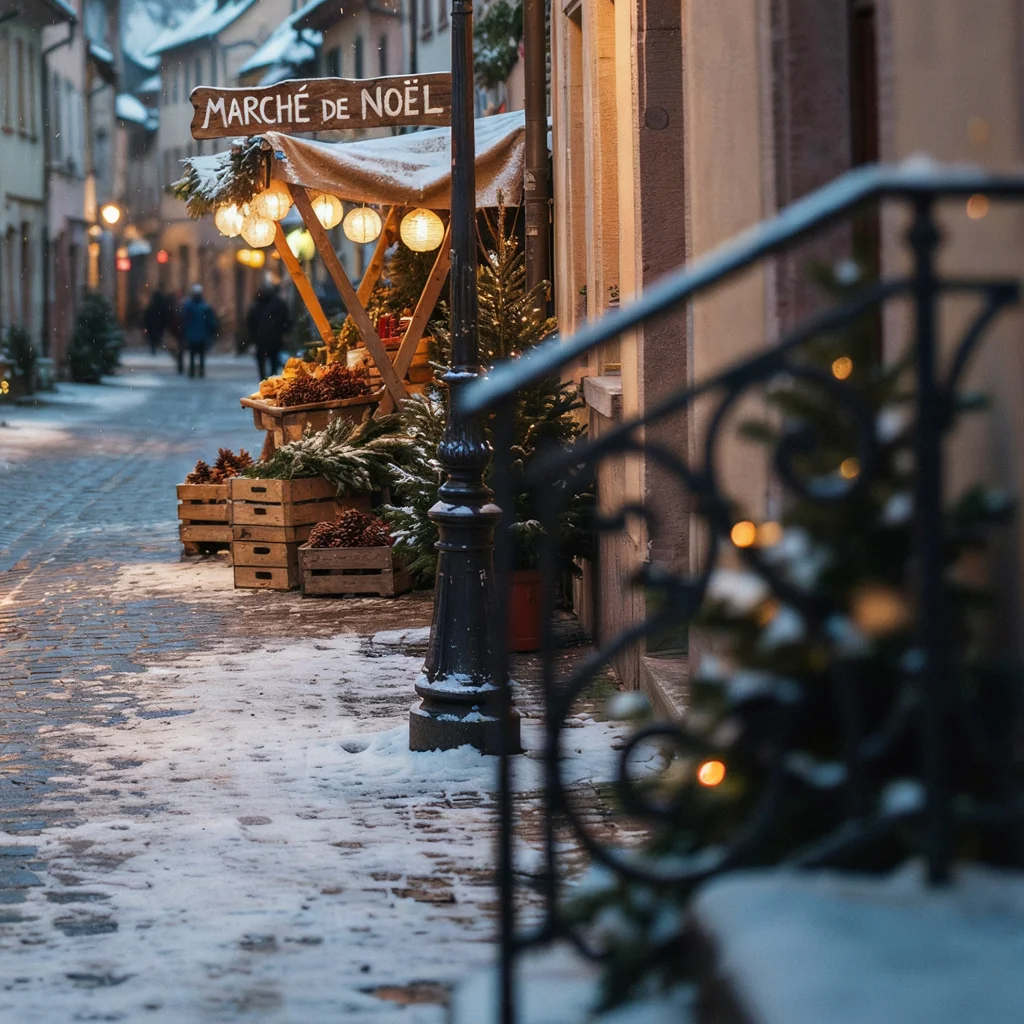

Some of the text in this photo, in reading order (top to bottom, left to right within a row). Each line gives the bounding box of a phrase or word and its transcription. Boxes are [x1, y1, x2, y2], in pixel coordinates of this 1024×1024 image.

[201, 78, 444, 129] MARCHÉ DE NOËL
